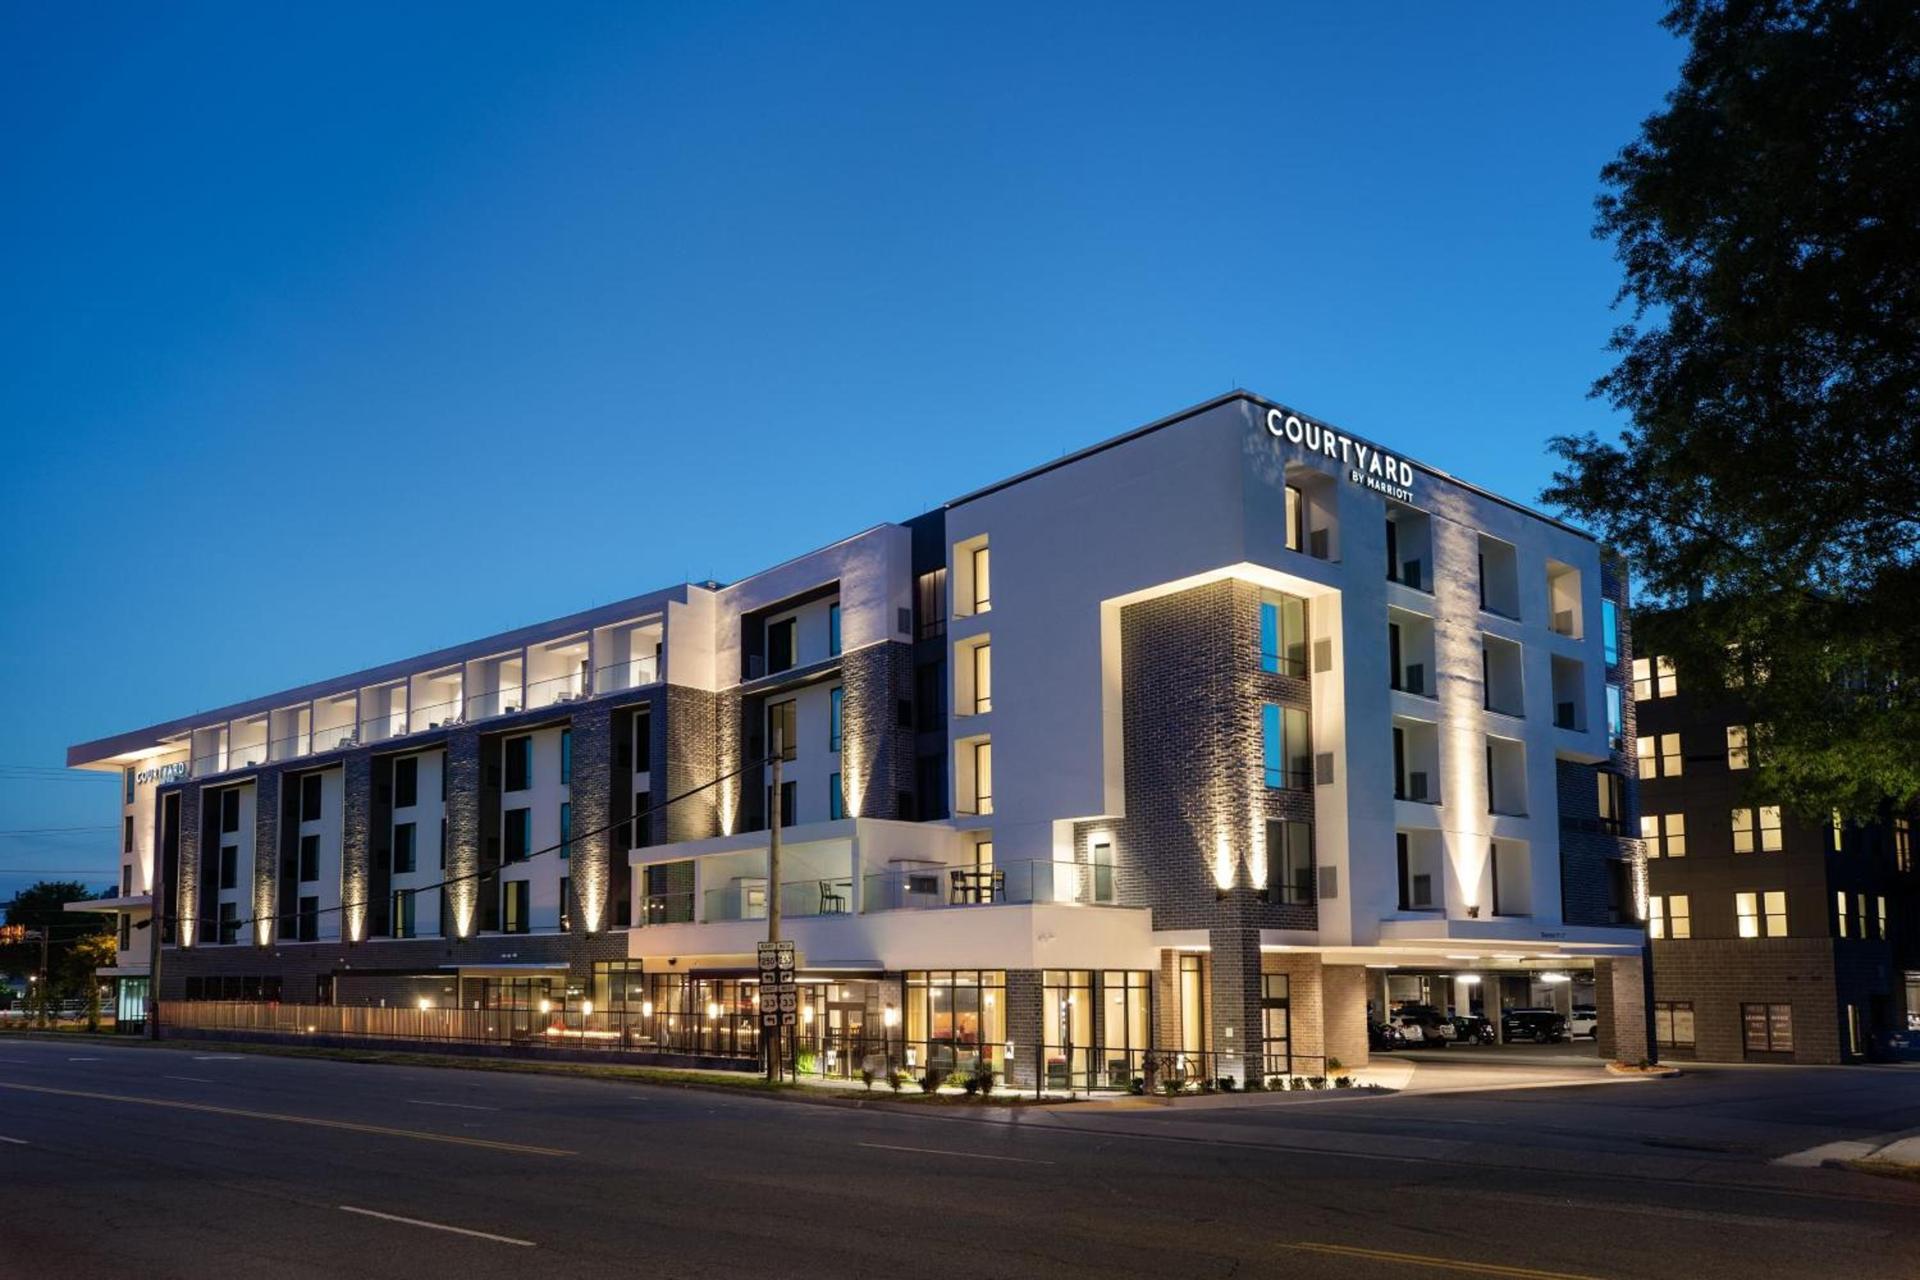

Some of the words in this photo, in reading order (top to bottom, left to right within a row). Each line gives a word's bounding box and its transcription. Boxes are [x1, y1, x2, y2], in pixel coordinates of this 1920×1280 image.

[1267, 409, 1413, 487] COURTYARD
[1352, 471, 1365, 482] BY
[1366, 477, 1413, 502] MARRIOTT
[763, 999, 776, 1008] 33
[783, 998, 794, 1007] 33
